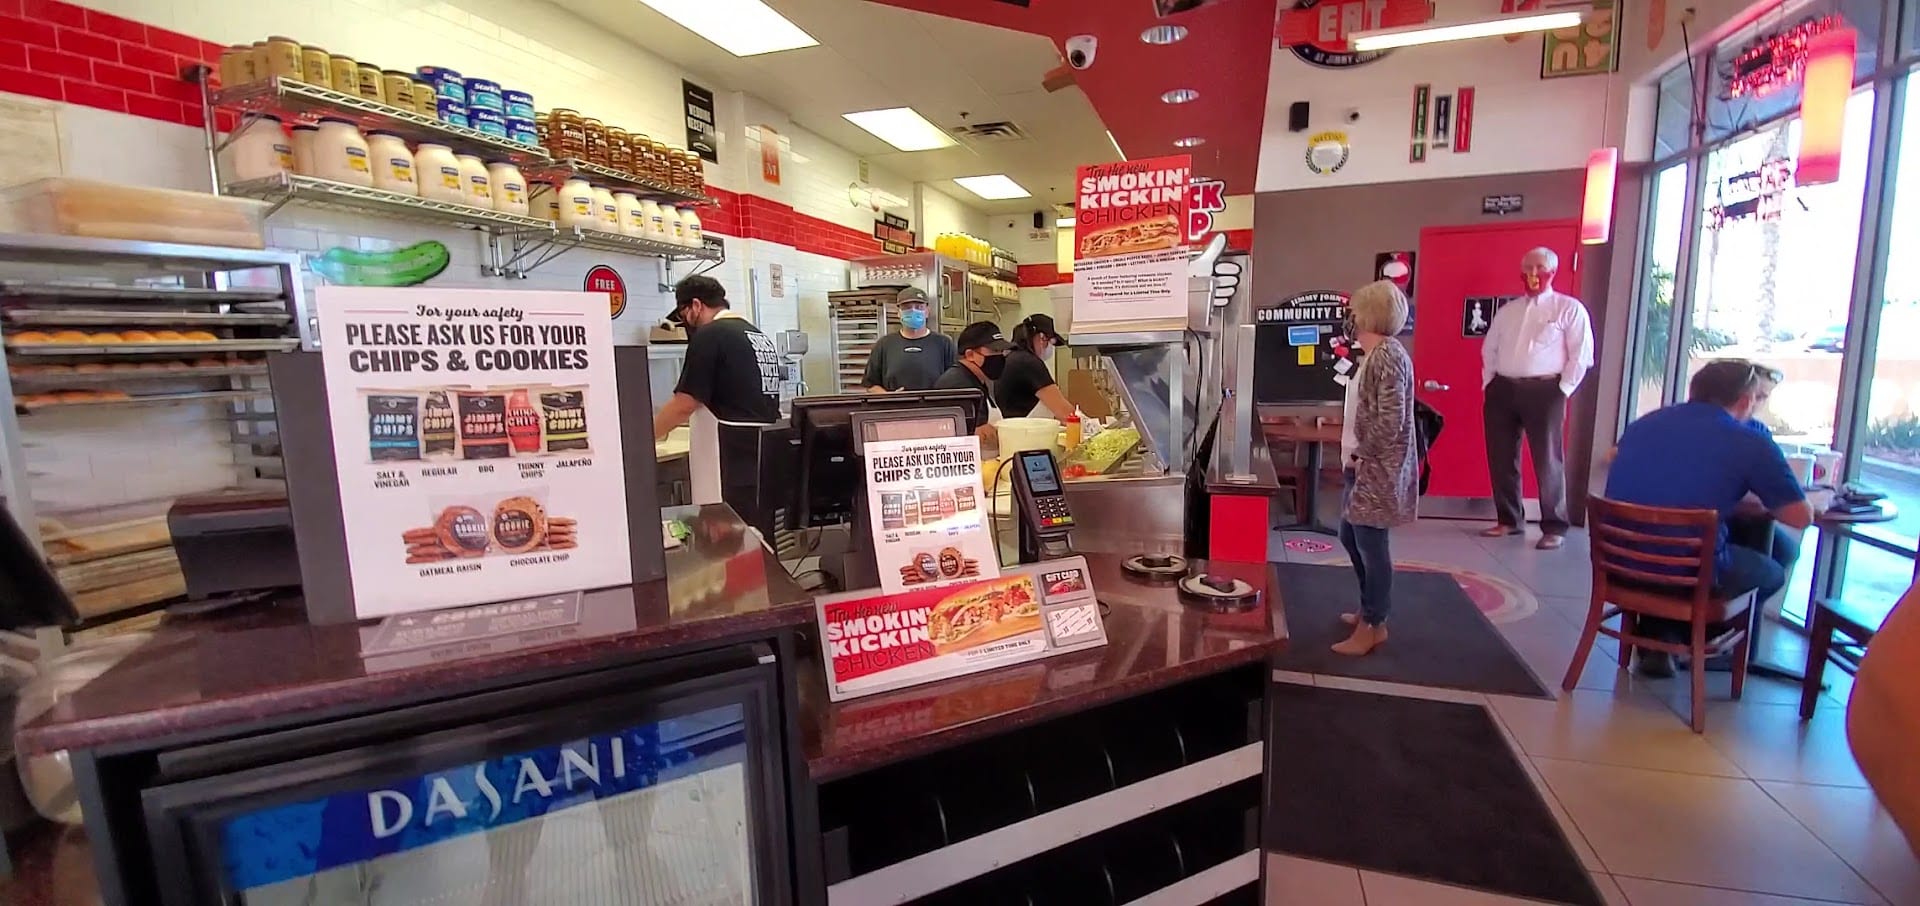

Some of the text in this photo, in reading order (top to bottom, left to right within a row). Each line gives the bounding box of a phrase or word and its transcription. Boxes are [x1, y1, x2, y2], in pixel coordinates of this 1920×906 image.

[1080, 168, 1189, 193] SMOKIN'
[1080, 185, 1189, 209] KICKIN'
[1080, 202, 1181, 224] CHICKEN
[595, 278, 615, 290] FREE
[416, 305, 524, 321] For your safety
[1258, 307, 1331, 321] COMMUNITY
[346, 324, 587, 346] PLEASE ASK US FOR YOUR
[350, 350, 589, 372] CHIPS & COOKIES
[374, 414, 413, 424] JIMMY
[465, 413, 502, 423] JIMMY
[549, 409, 581, 419] JIMMY
[374, 425, 413, 435] CHIPS
[465, 423, 504, 433] CHIPS
[549, 419, 584, 429] CHIPS
[929, 444, 947, 452] safety
[556, 459, 592, 468] JALAPEÑO
[873, 451, 975, 469] PLEASE ASK US FOR YOUR
[421, 468, 458, 477] REGULAR
[478, 465, 494, 473] BBQ
[517, 462, 545, 471] THINNY
[377, 471, 395, 479] SALT
[874, 464, 975, 483] CHIPS & COOKIES
[374, 480, 410, 488] VINEGAR
[510, 554, 570, 567] CHOCOLATE CHIP
[420, 563, 482, 577] OATMEAL RAISIN
[1046, 570, 1079, 582] GIFT CARD
[827, 607, 931, 640] SMOKIN'
[983, 646, 1004, 654] LIMITED
[1019, 640, 1031, 648] ONLY
[834, 642, 935, 675] CHICKEN
[368, 737, 624, 839] DASANI
